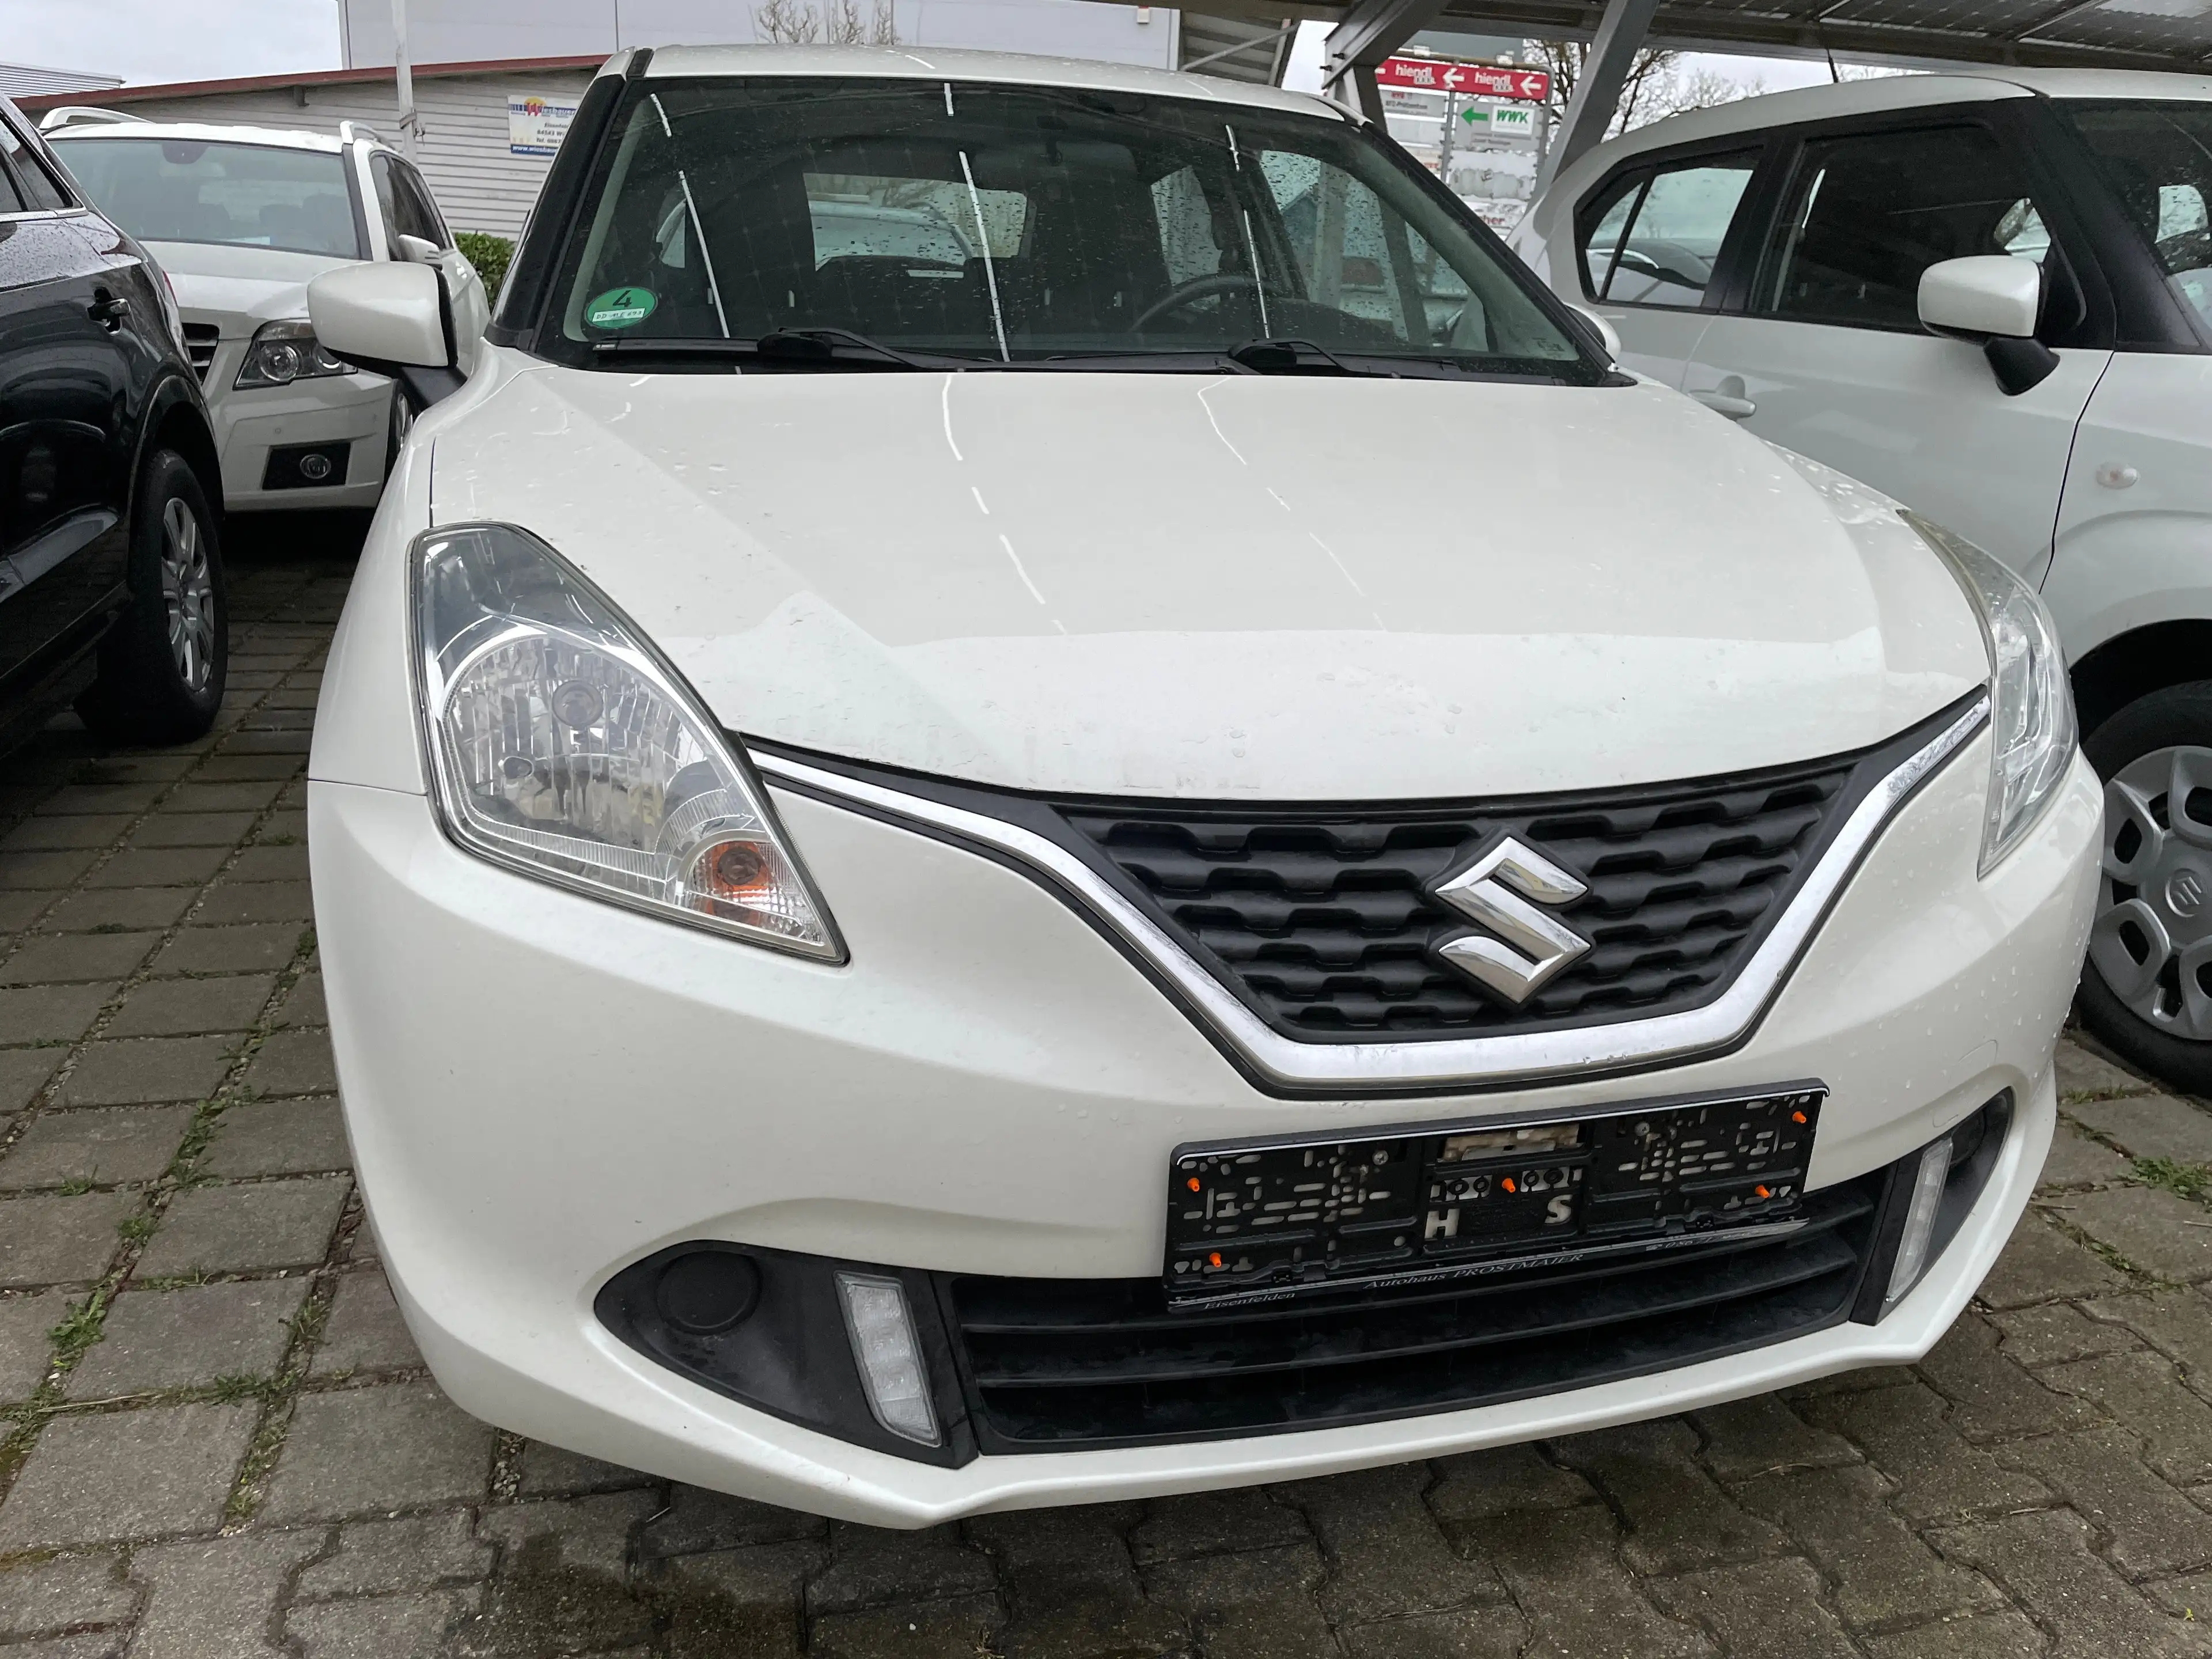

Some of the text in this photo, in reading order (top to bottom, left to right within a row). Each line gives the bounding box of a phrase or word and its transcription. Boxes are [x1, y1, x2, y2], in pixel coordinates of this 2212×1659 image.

[1395, 63, 1432, 78] hiendl
[1475, 71, 1511, 86] hiendl
[1497, 109, 1528, 123] WWK
[612, 290, 632, 308] 4
[1362, 1254, 1584, 1290] Autohaus PROSTMAIER
[1204, 1292, 1296, 1310] Eisenfelden
